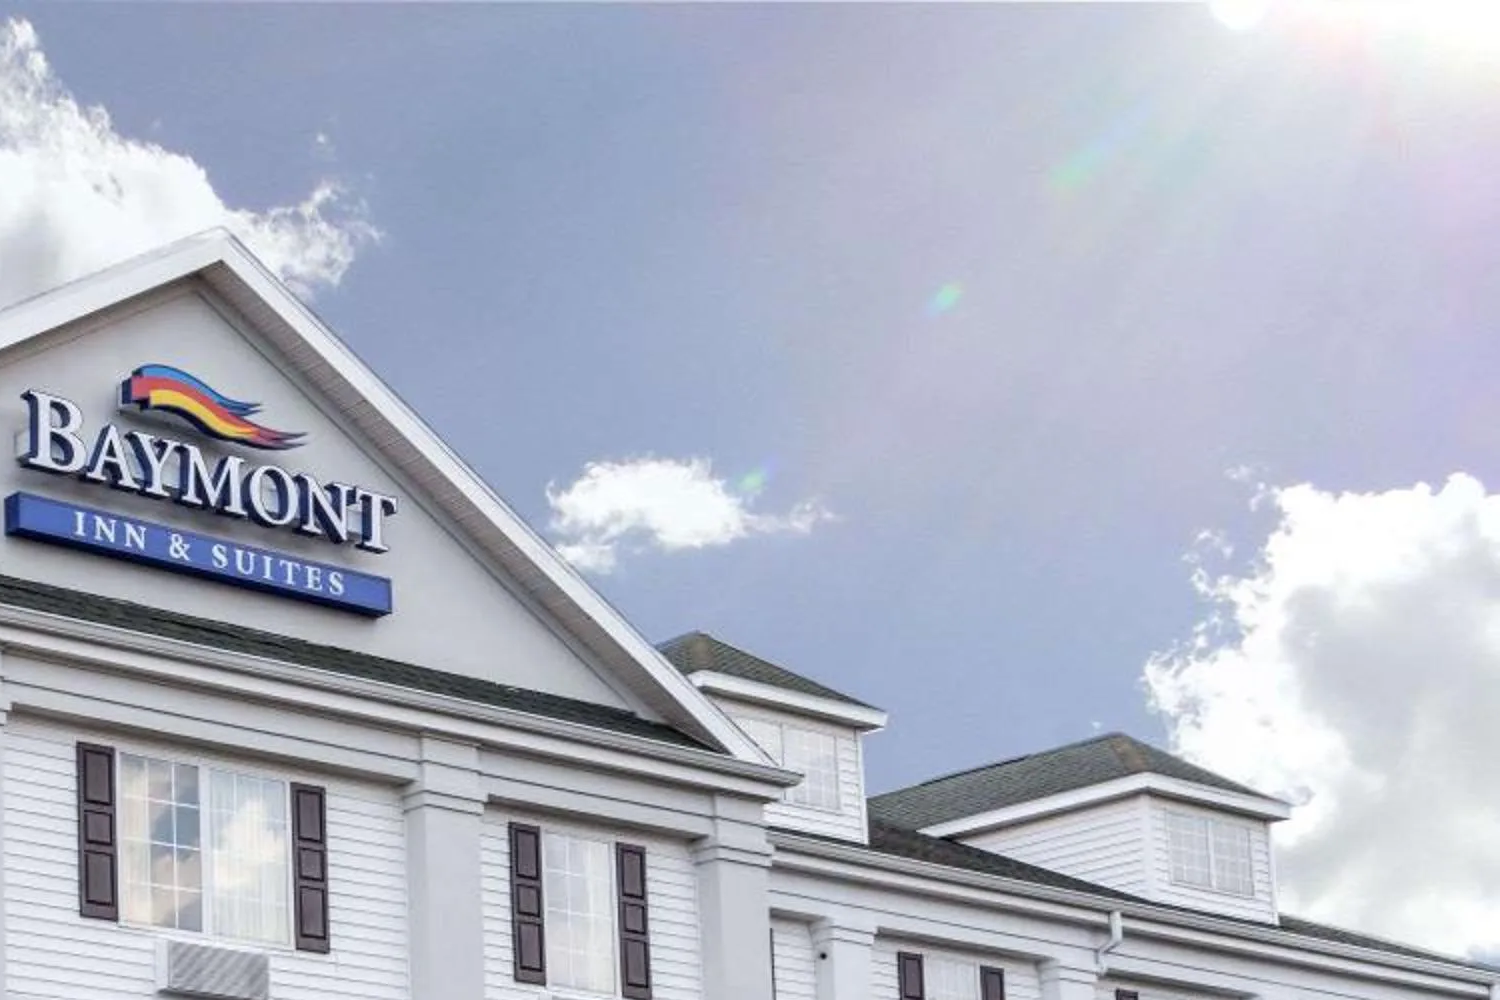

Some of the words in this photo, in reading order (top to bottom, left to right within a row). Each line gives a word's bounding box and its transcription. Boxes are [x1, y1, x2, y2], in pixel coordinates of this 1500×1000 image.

[19, 389, 398, 553] BAYMONT
[73, 511, 147, 551] INN
[169, 532, 191, 561] &
[211, 547, 345, 596] SUITES
